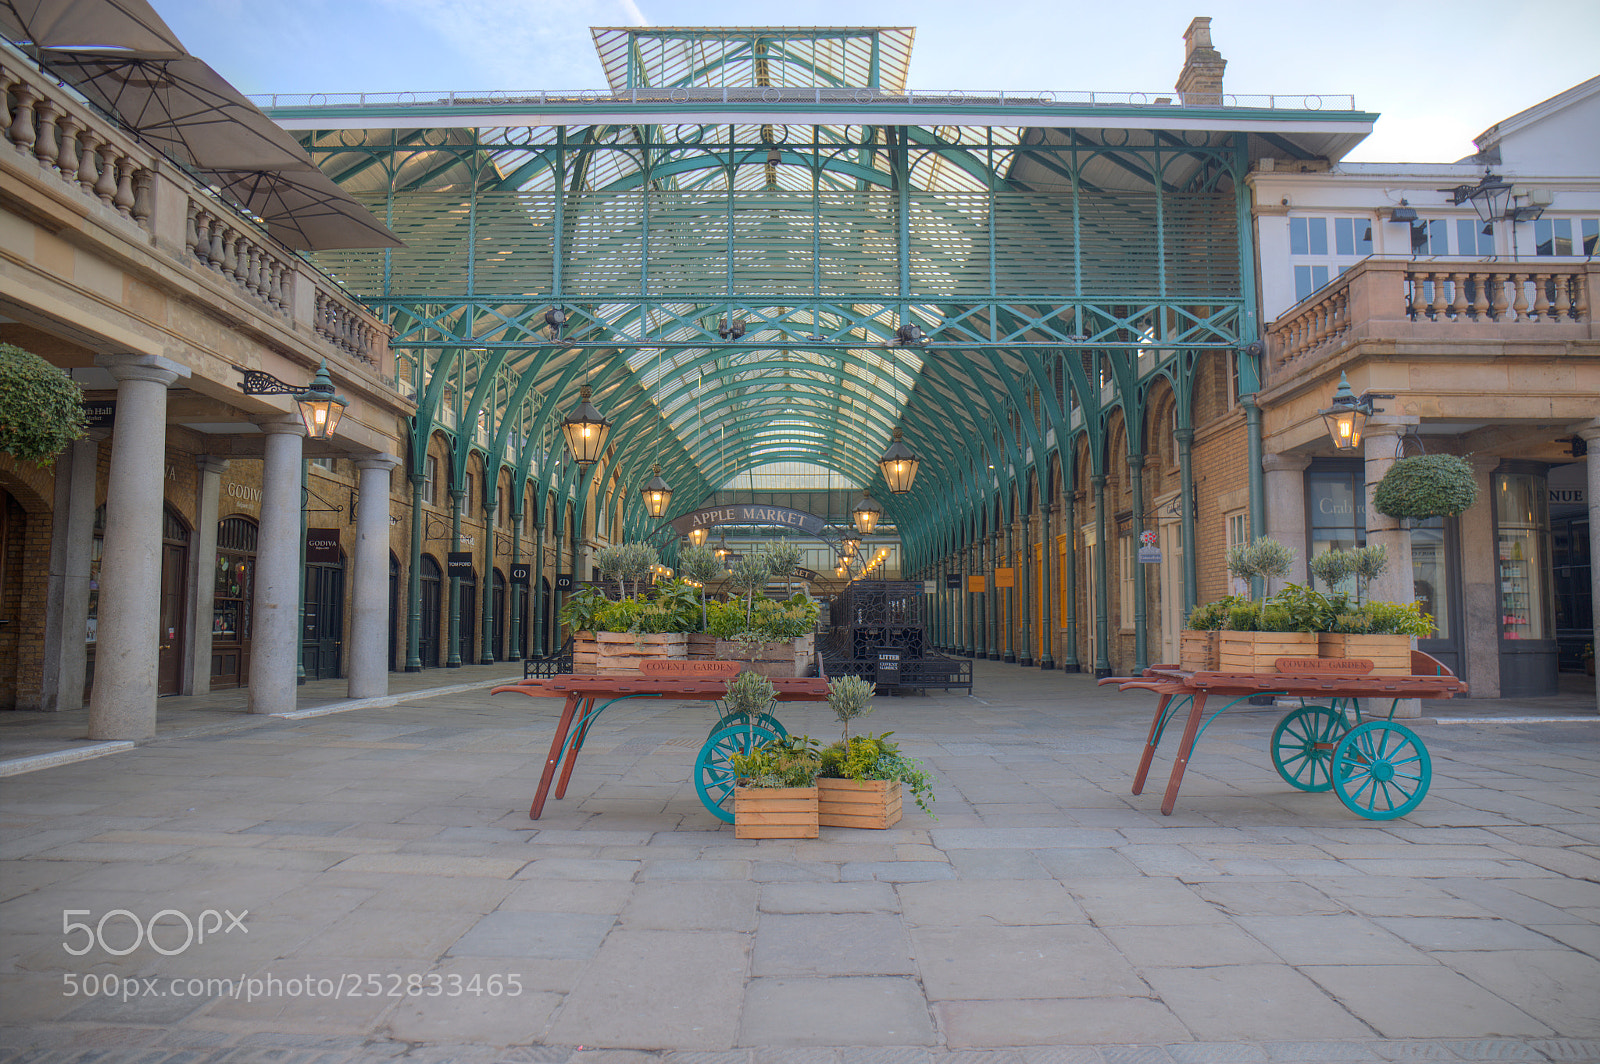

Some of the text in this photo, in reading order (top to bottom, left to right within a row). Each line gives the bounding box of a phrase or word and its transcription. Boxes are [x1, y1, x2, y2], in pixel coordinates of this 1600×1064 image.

[94, 407, 113, 415] Hall
[692, 507, 808, 527] APPLE MARKET
[646, 662, 734, 672] COVENT GARDEN
[1282, 660, 1368, 670] COVENT GARDEN
